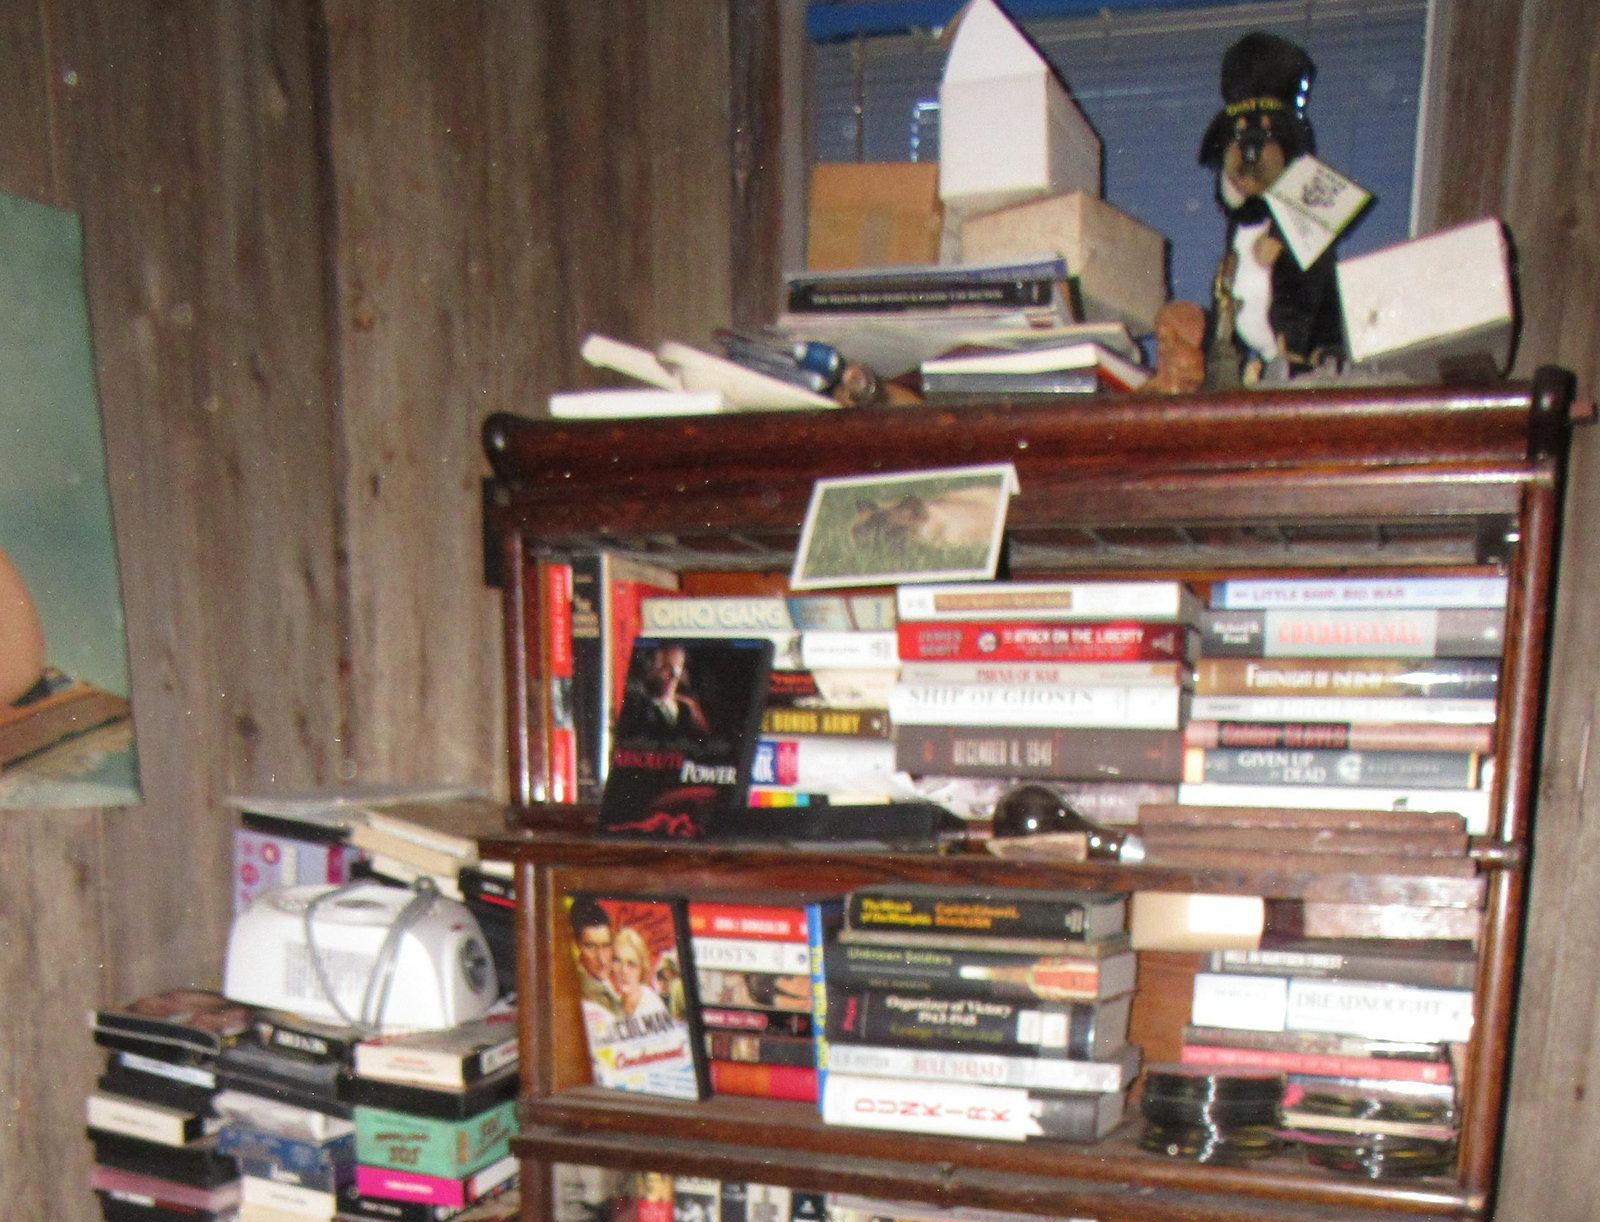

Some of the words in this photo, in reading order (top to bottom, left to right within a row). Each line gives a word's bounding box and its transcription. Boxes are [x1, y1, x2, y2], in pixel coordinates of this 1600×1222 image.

[717, 601, 787, 630] GANG
[1071, 629, 1094, 643] THE
[1095, 629, 1145, 644] LIBERTY
[1278, 621, 1424, 646] GUADALCANAL
[908, 686, 963, 703] SHIP
[1001, 687, 1095, 705] GHOSTS
[821, 710, 861, 735] ARMY
[1237, 751, 1290, 768] GIVEN
[1282, 767, 1327, 783] DEAD
[886, 994, 949, 1012] Organizer
[966, 997, 1013, 1018] Victory
[1295, 991, 1444, 1017] DREADNOUGHT
[853, 1097, 1012, 1123] DUNKIRK
